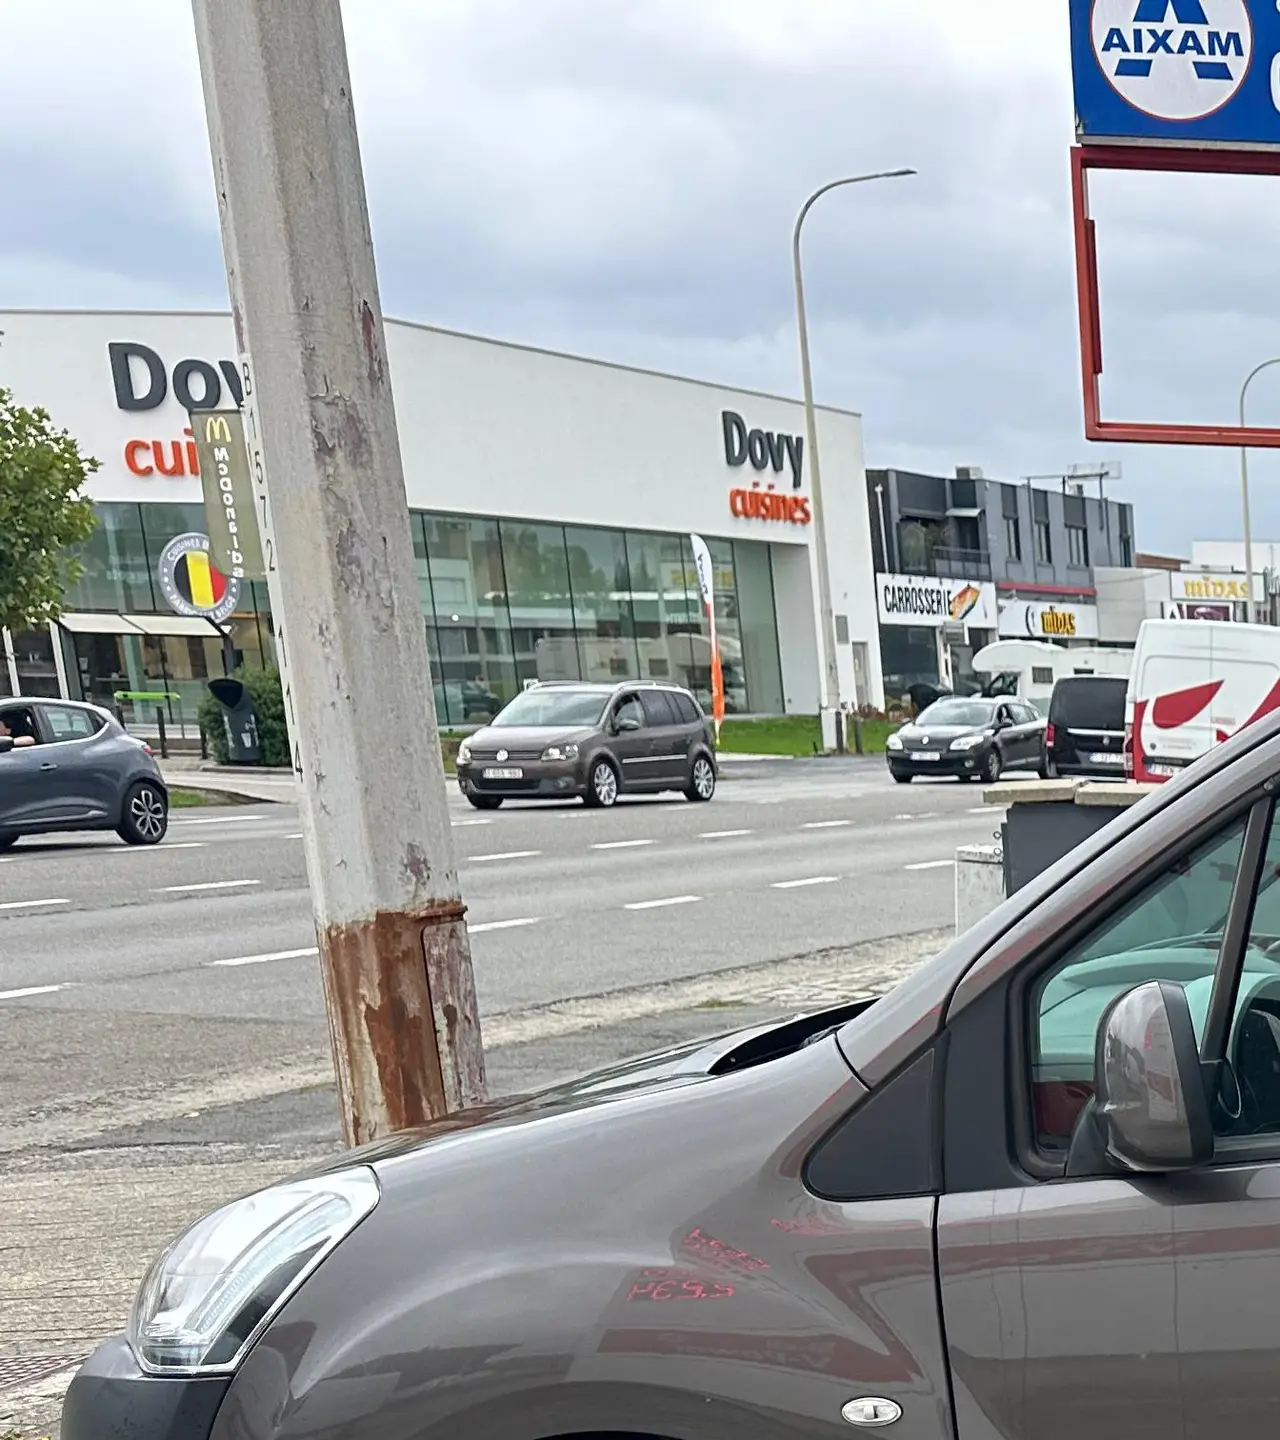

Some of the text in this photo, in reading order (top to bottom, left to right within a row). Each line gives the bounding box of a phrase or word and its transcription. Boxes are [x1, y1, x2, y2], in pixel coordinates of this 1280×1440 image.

[1102, 27, 1244, 57] AIXAM
[722, 411, 803, 489] Dovy
[730, 481, 811, 525] cuisines
[884, 584, 954, 616] CARROSSERIE
